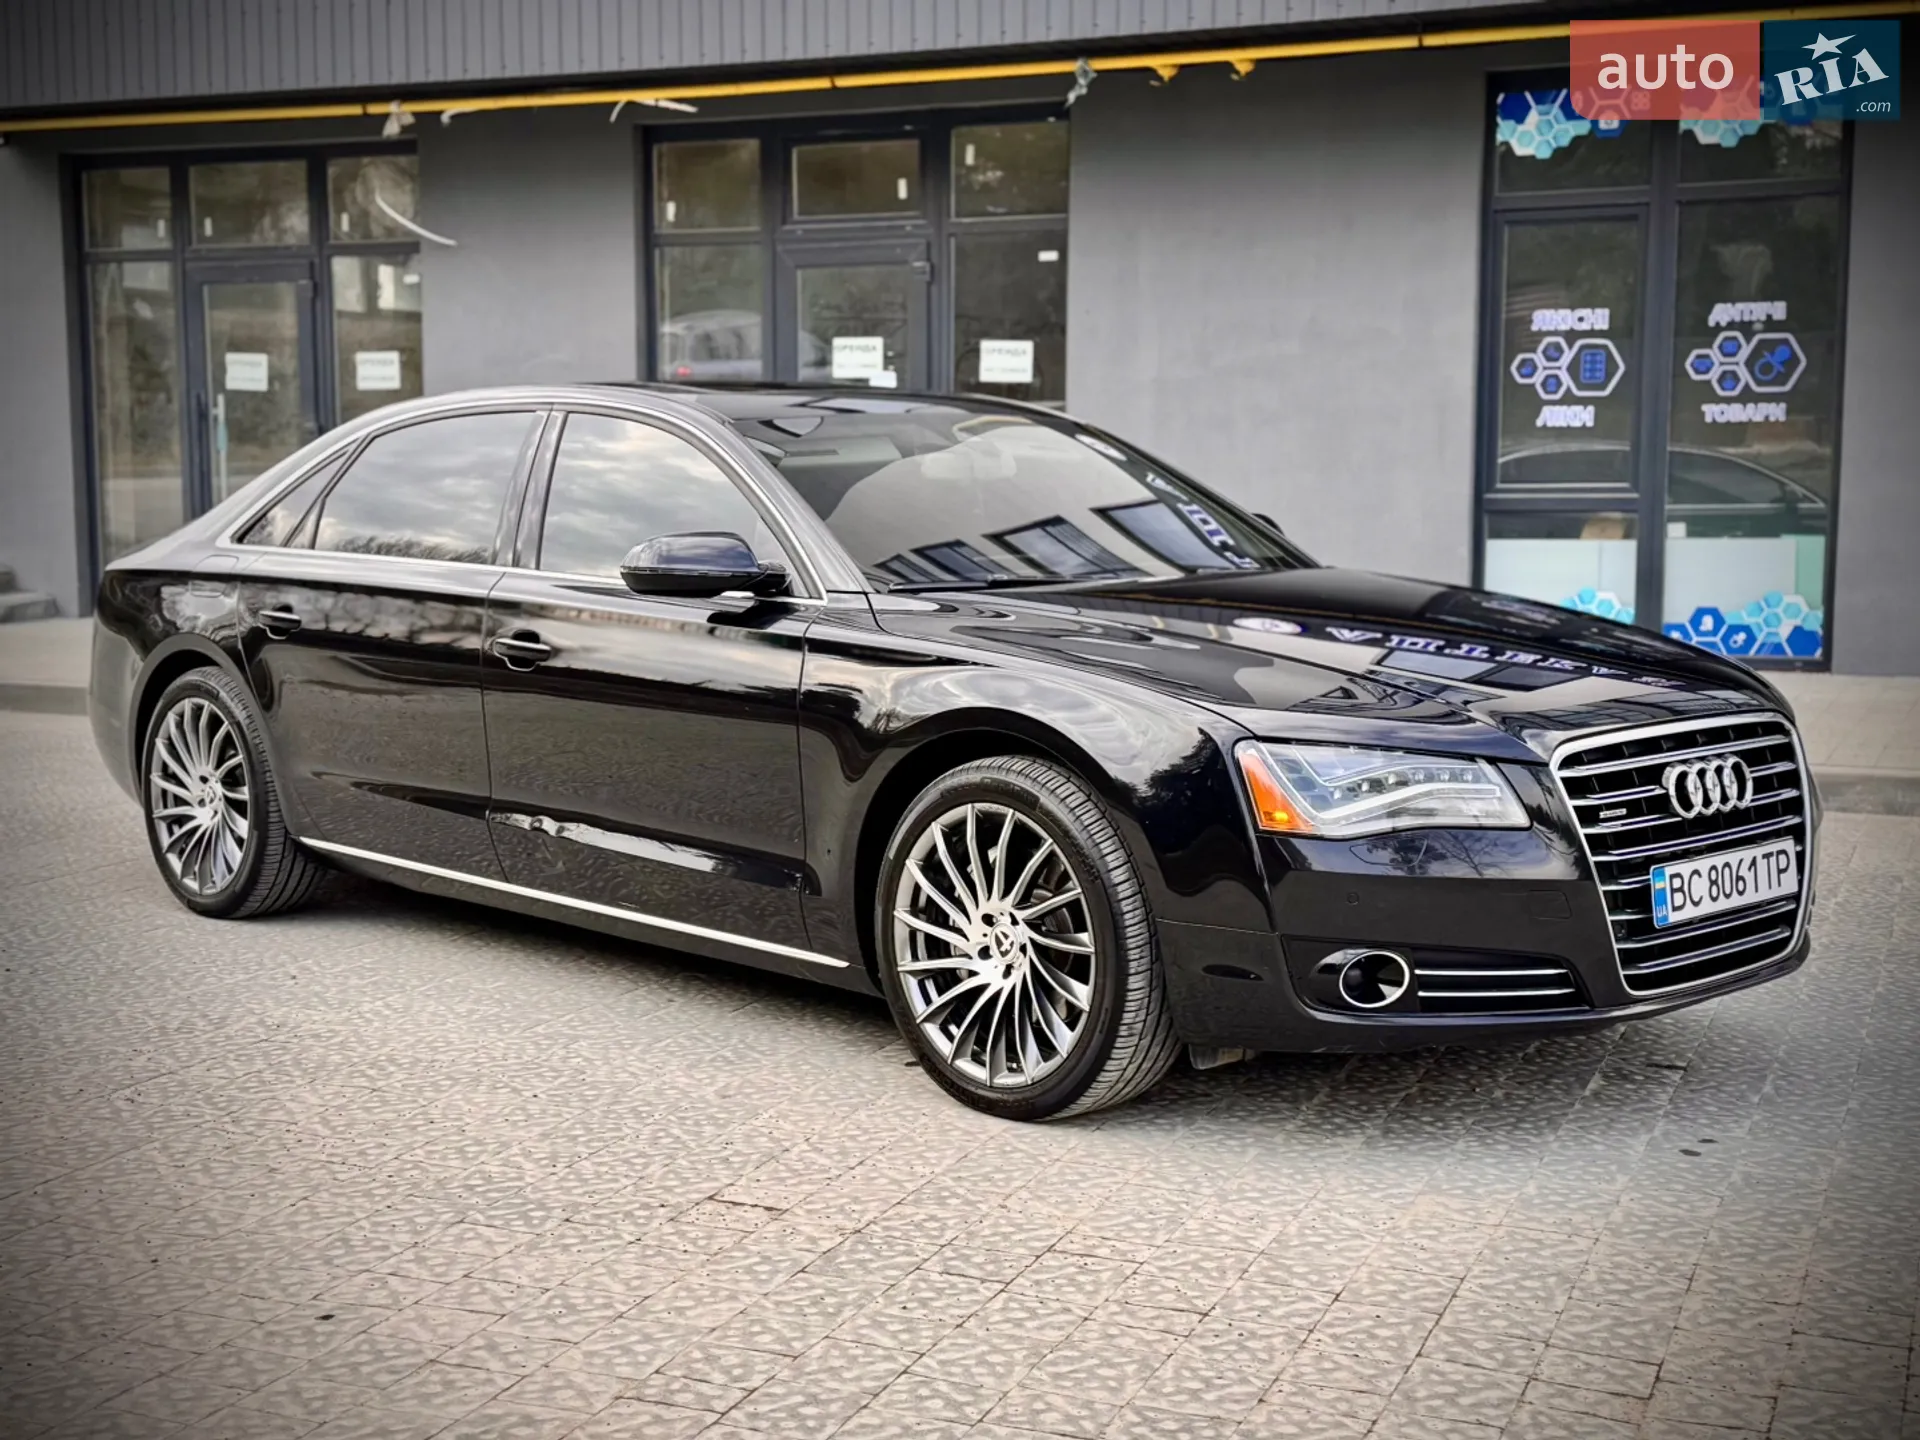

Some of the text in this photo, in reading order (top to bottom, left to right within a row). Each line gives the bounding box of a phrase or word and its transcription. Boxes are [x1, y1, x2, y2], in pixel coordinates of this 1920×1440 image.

[1669, 849, 1791, 912] BC 8061 TP
[1656, 904, 1668, 917] UA
